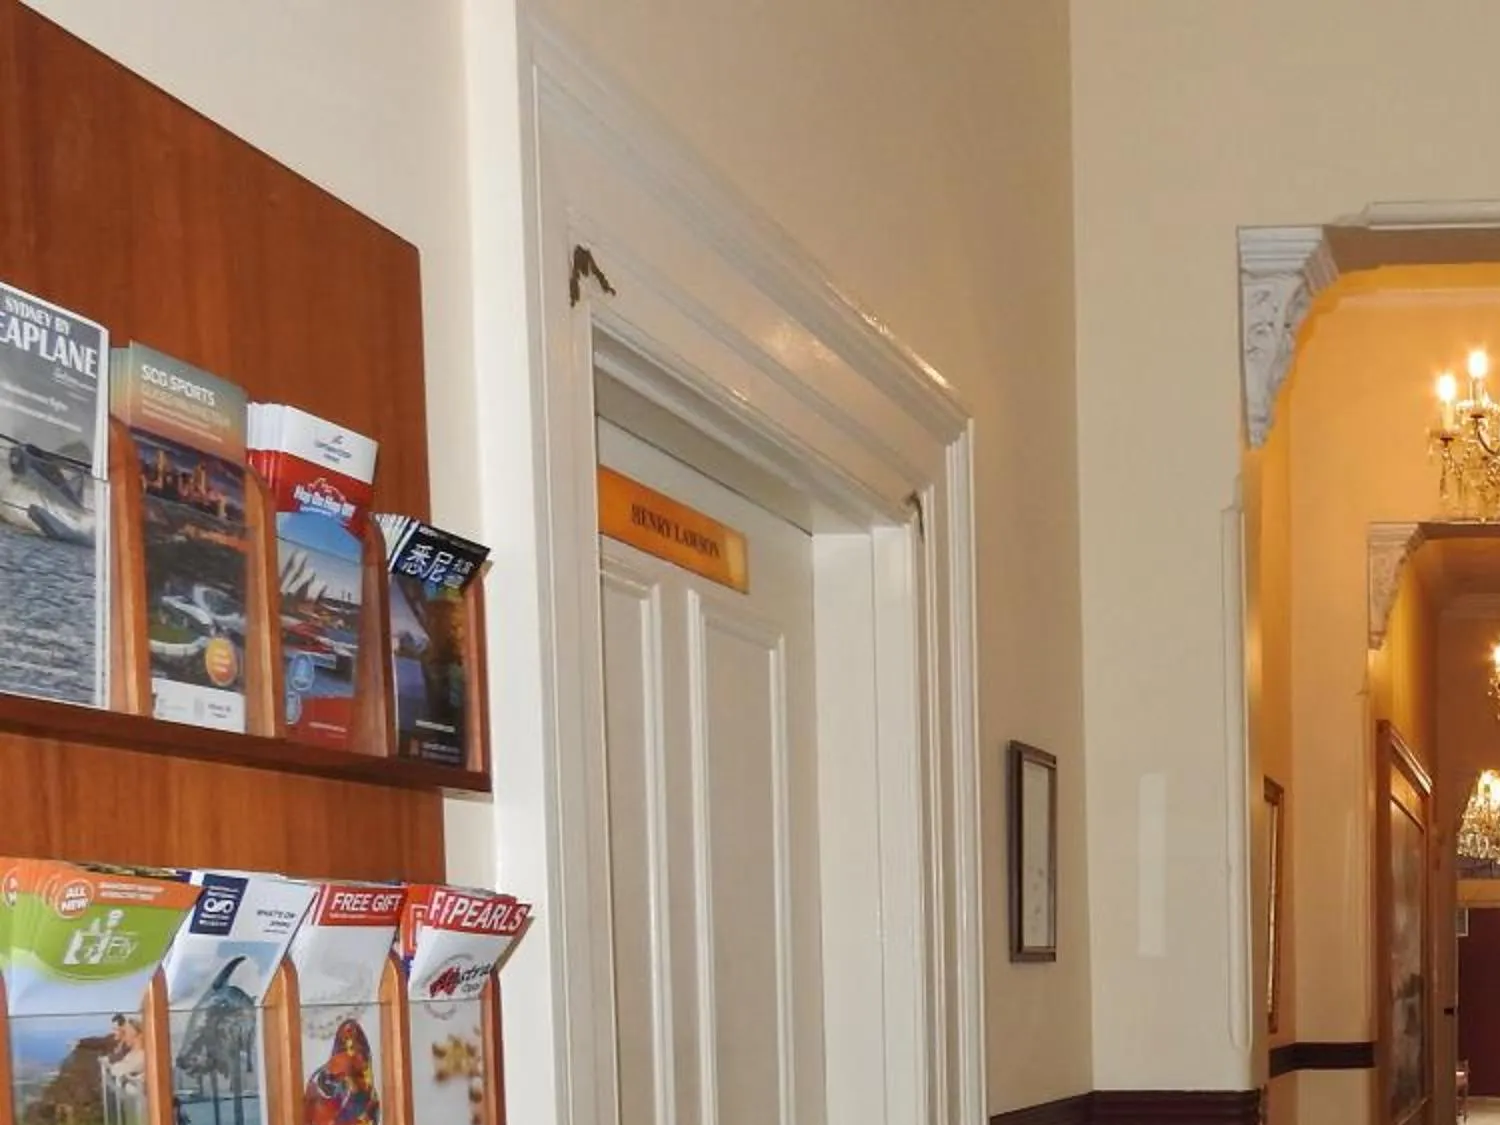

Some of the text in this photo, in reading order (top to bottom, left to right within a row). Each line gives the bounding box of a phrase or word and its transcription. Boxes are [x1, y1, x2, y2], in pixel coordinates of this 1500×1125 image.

[0, 310, 98, 379] EAPLANE
[631, 503, 721, 560] HENRY LAWSON
[330, 892, 403, 913] FREE GIFT
[447, 897, 527, 932] PEARLS
